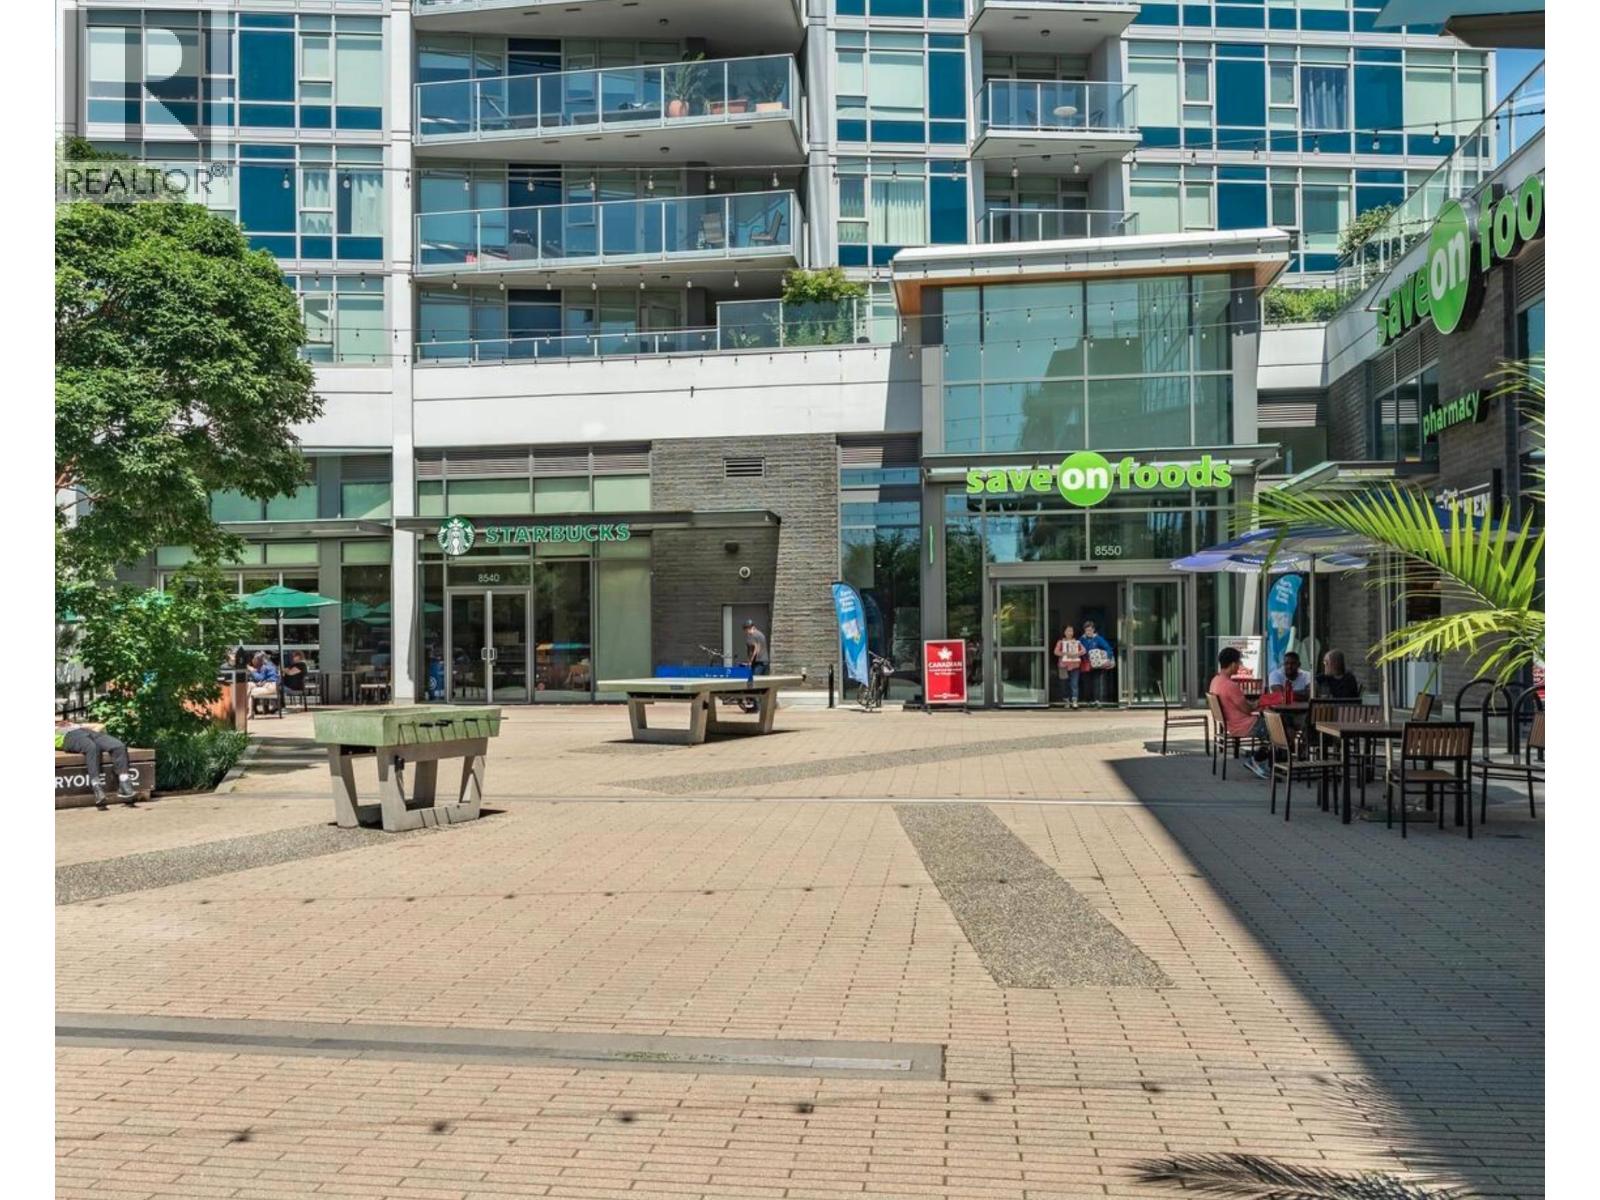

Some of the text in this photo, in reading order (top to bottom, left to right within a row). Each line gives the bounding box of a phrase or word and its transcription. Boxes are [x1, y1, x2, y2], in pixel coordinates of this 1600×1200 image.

[1376, 264, 1430, 346] save
[1431, 231, 1466, 301] on
[1423, 390, 1480, 444] pharmacy
[966, 455, 1232, 494] save on foods
[485, 523, 631, 544] STARBUCKS
[1094, 545, 1122, 556] 8550
[478, 573, 500, 583] 8540
